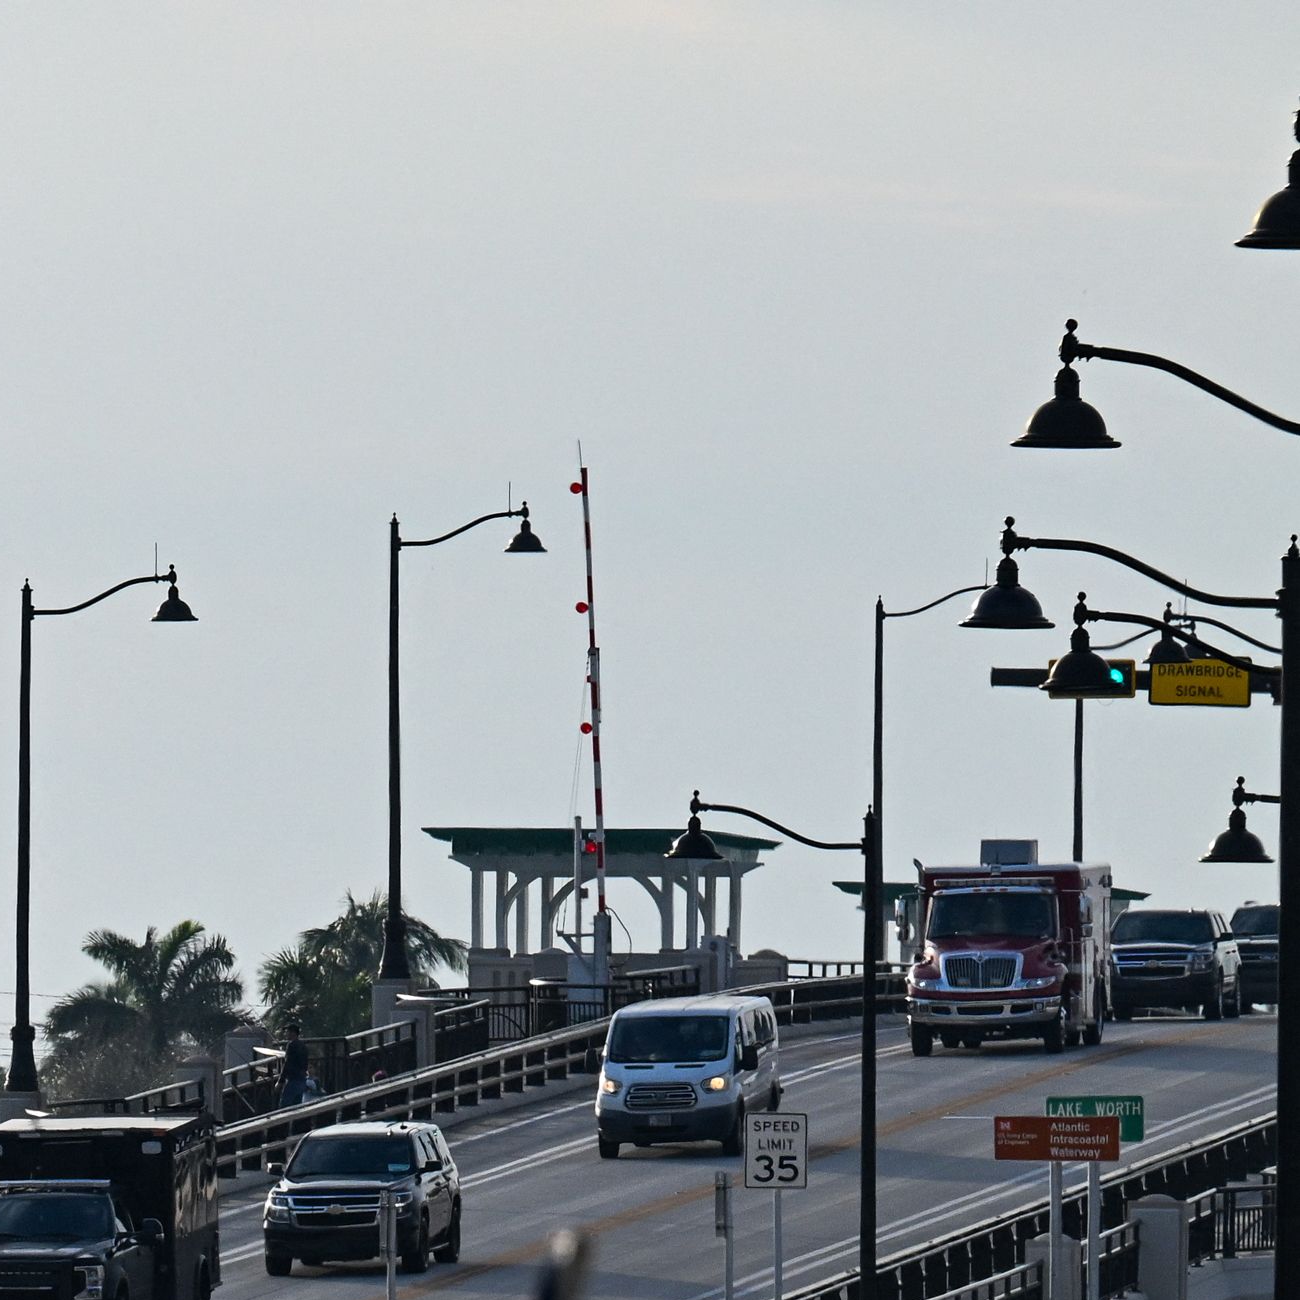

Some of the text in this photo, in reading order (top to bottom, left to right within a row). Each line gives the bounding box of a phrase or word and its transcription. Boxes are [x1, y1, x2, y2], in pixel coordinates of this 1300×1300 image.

[1157, 664, 1243, 679] DRAWBRIDGE
[1175, 685, 1224, 698] SIGNAL
[1048, 1101, 1141, 1117] LAKE WORTH
[753, 1120, 800, 1132] SPEED
[1049, 1122, 1090, 1132] Atlantic
[758, 1138, 795, 1151] LIMIT
[1049, 1134, 1109, 1145] Intracoastal
[1049, 1147, 1101, 1159] Waterway
[753, 1154, 799, 1183] 35
